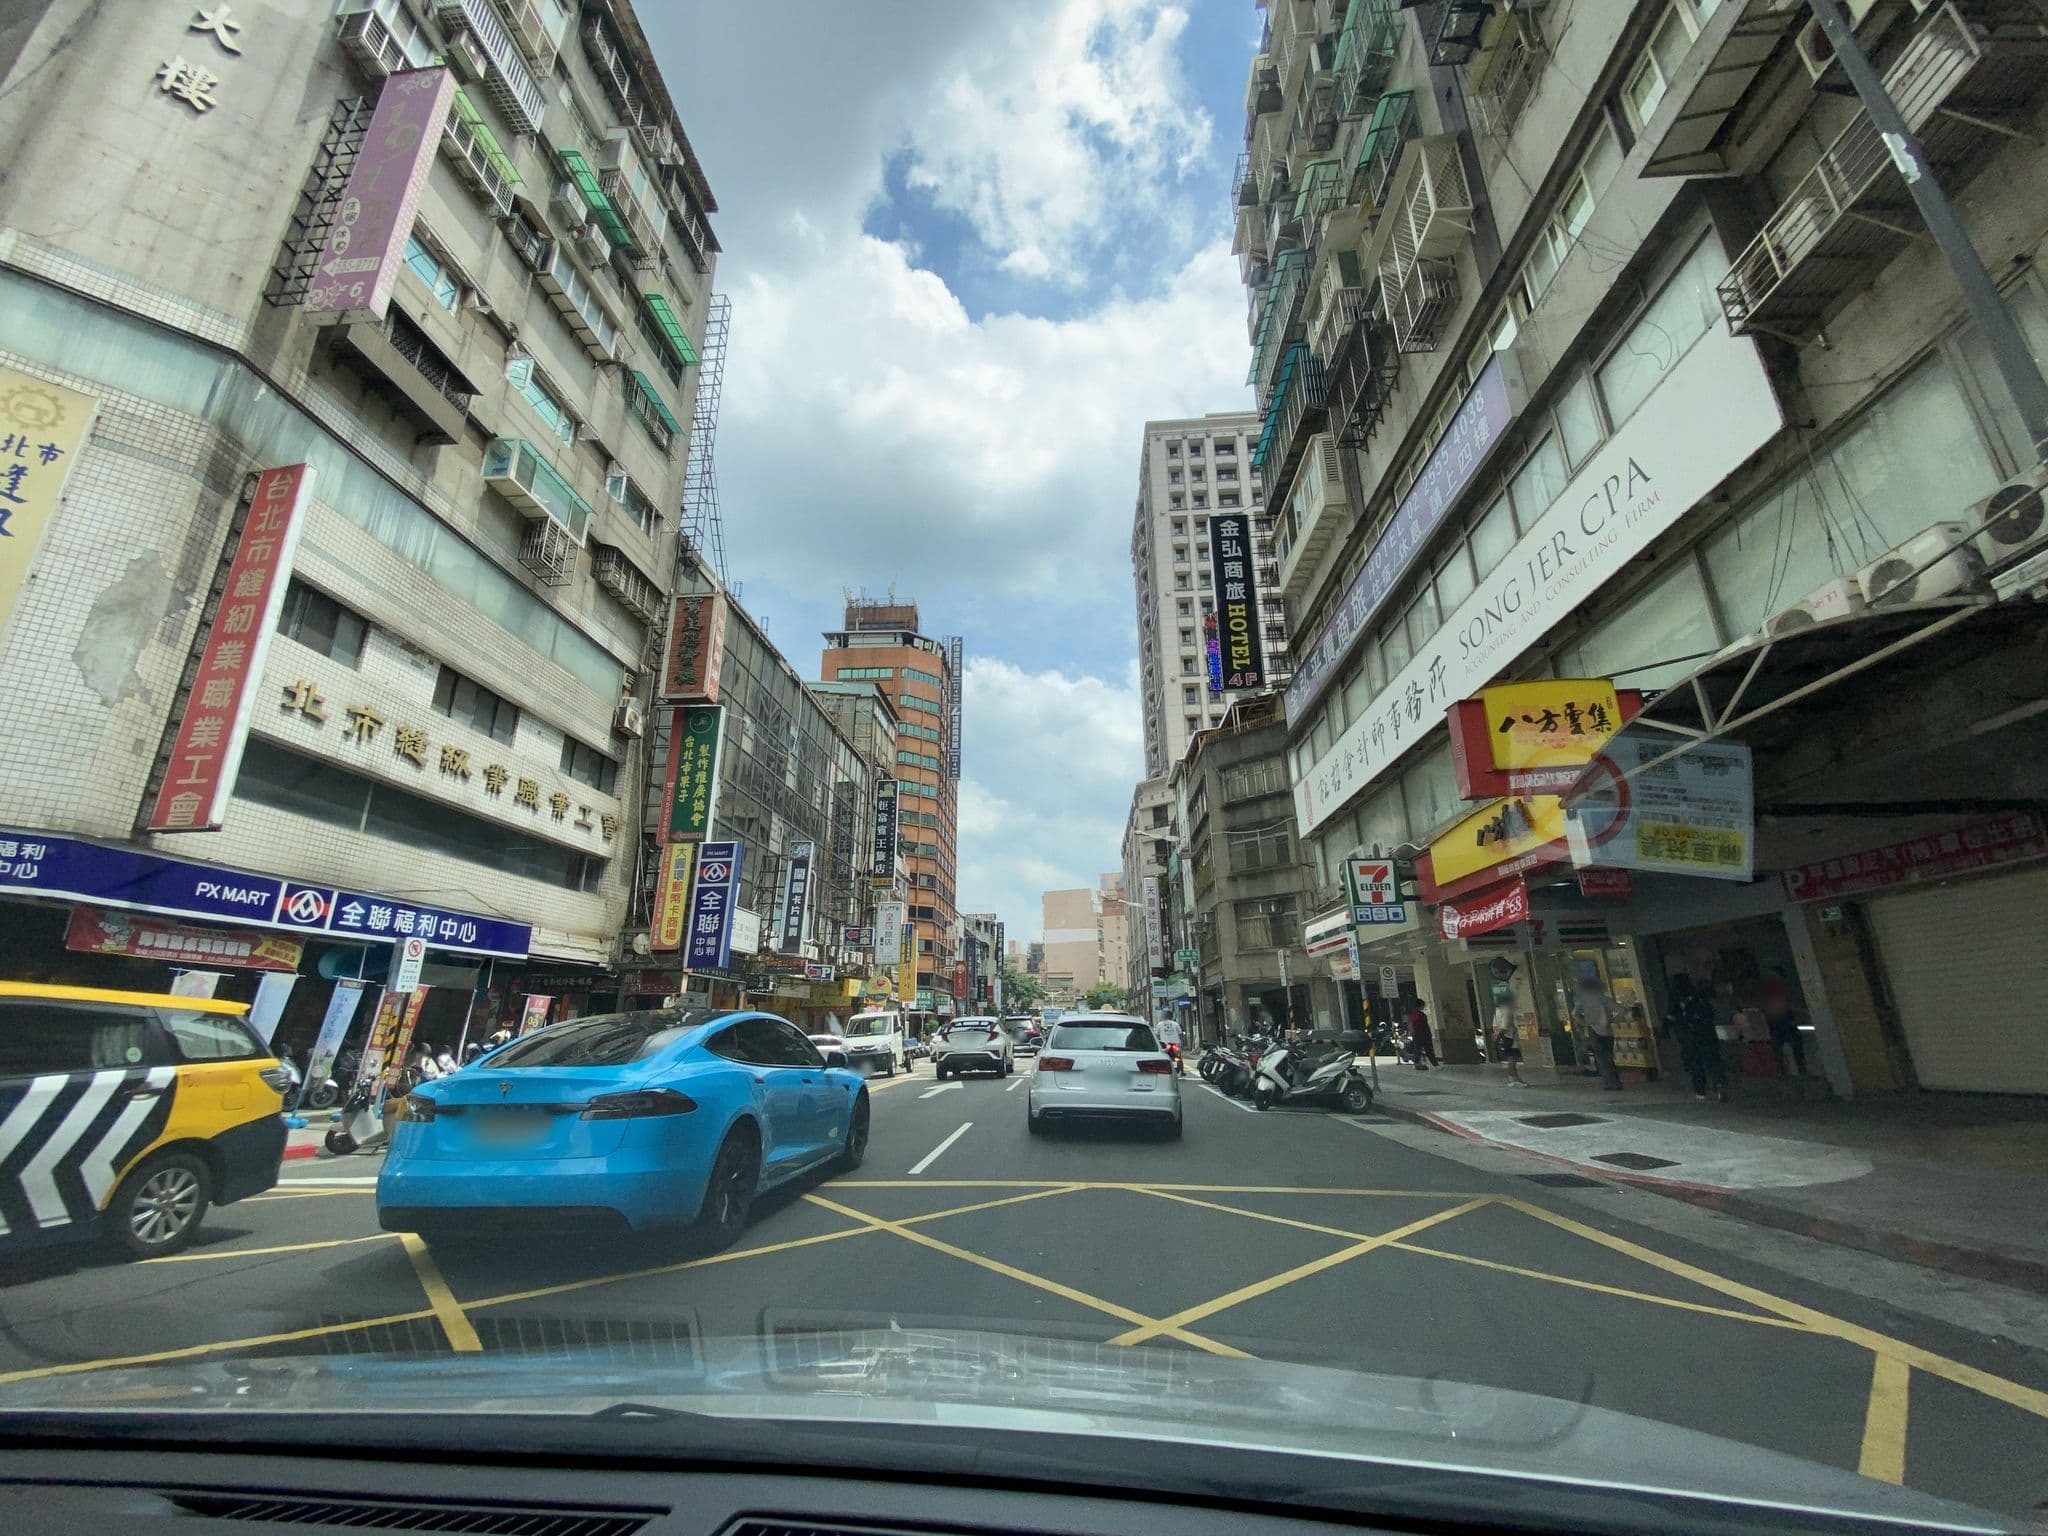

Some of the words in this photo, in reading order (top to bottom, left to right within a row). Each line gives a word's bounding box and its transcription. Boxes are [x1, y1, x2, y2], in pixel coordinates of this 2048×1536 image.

[1430, 421, 1491, 519] 請上四樓
[1219, 519, 1247, 601] 金弘商旅
[1367, 529, 1404, 582] HOTEL
[1406, 494, 1420, 519] 02
[1458, 577, 1522, 660] SONG
[1527, 529, 1576, 598] JER
[1579, 456, 1653, 537] CPA
[1464, 627, 1517, 677] ACCOUNTING
[1519, 599, 1542, 627] AND
[1545, 528, 1619, 602] CONSULTING
[1624, 490, 1661, 529] FIRM
[165, 472, 294, 829] 台北市縫紉業職業工會
[1227, 603, 1251, 671] HOTEL
[1228, 672, 1258, 687] 4F
[1499, 702, 1612, 736] 八方雲集
[195, 881, 221, 899] PX
[222, 886, 271, 907] MART
[338, 900, 477, 944] 全聯福利中心
[696, 890, 723, 934] 全聯
[820, 968, 831, 978] P
